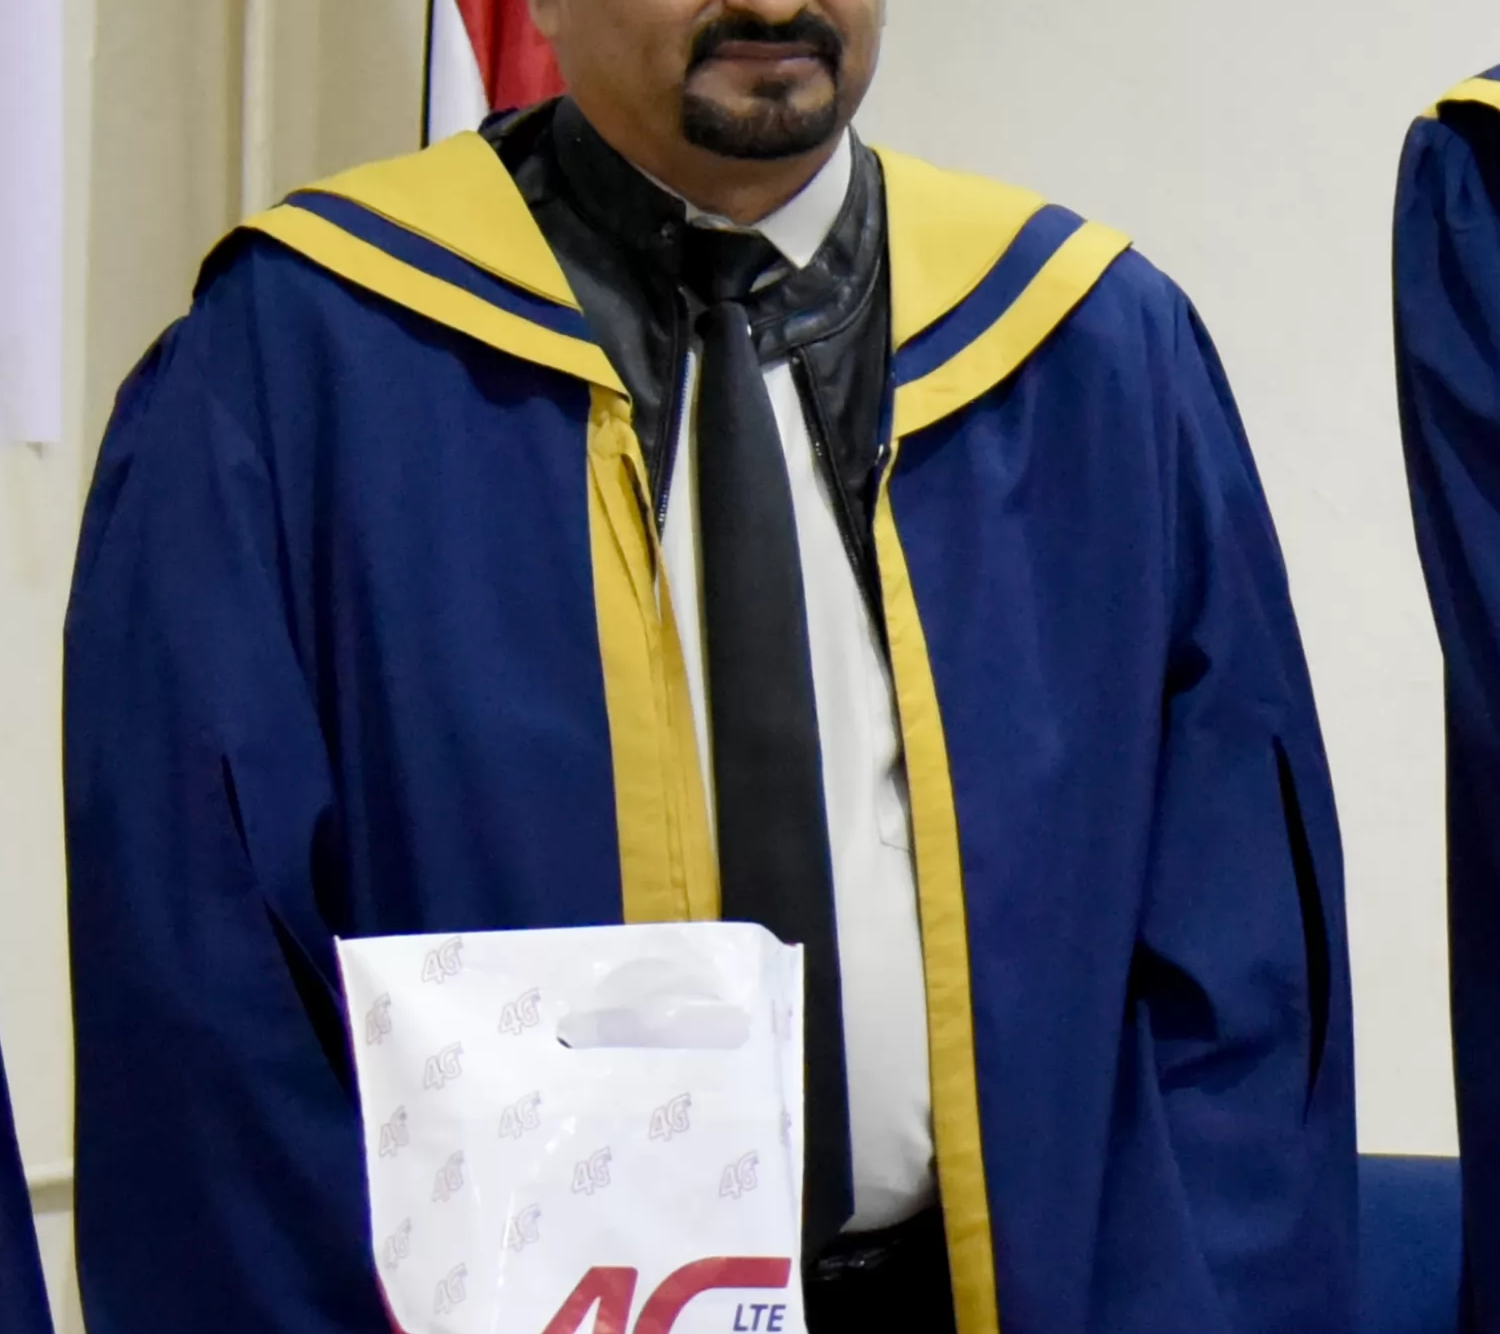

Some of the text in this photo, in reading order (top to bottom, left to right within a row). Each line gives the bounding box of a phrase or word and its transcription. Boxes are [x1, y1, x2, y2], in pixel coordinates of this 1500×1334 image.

[498, 988, 542, 1036] 4G
[423, 1041, 464, 1091] 4G
[648, 1093, 692, 1142] 4G
[571, 1147, 613, 1196] 4G
[719, 1150, 759, 1200] 4G
[733, 1303, 786, 1333] LTE
